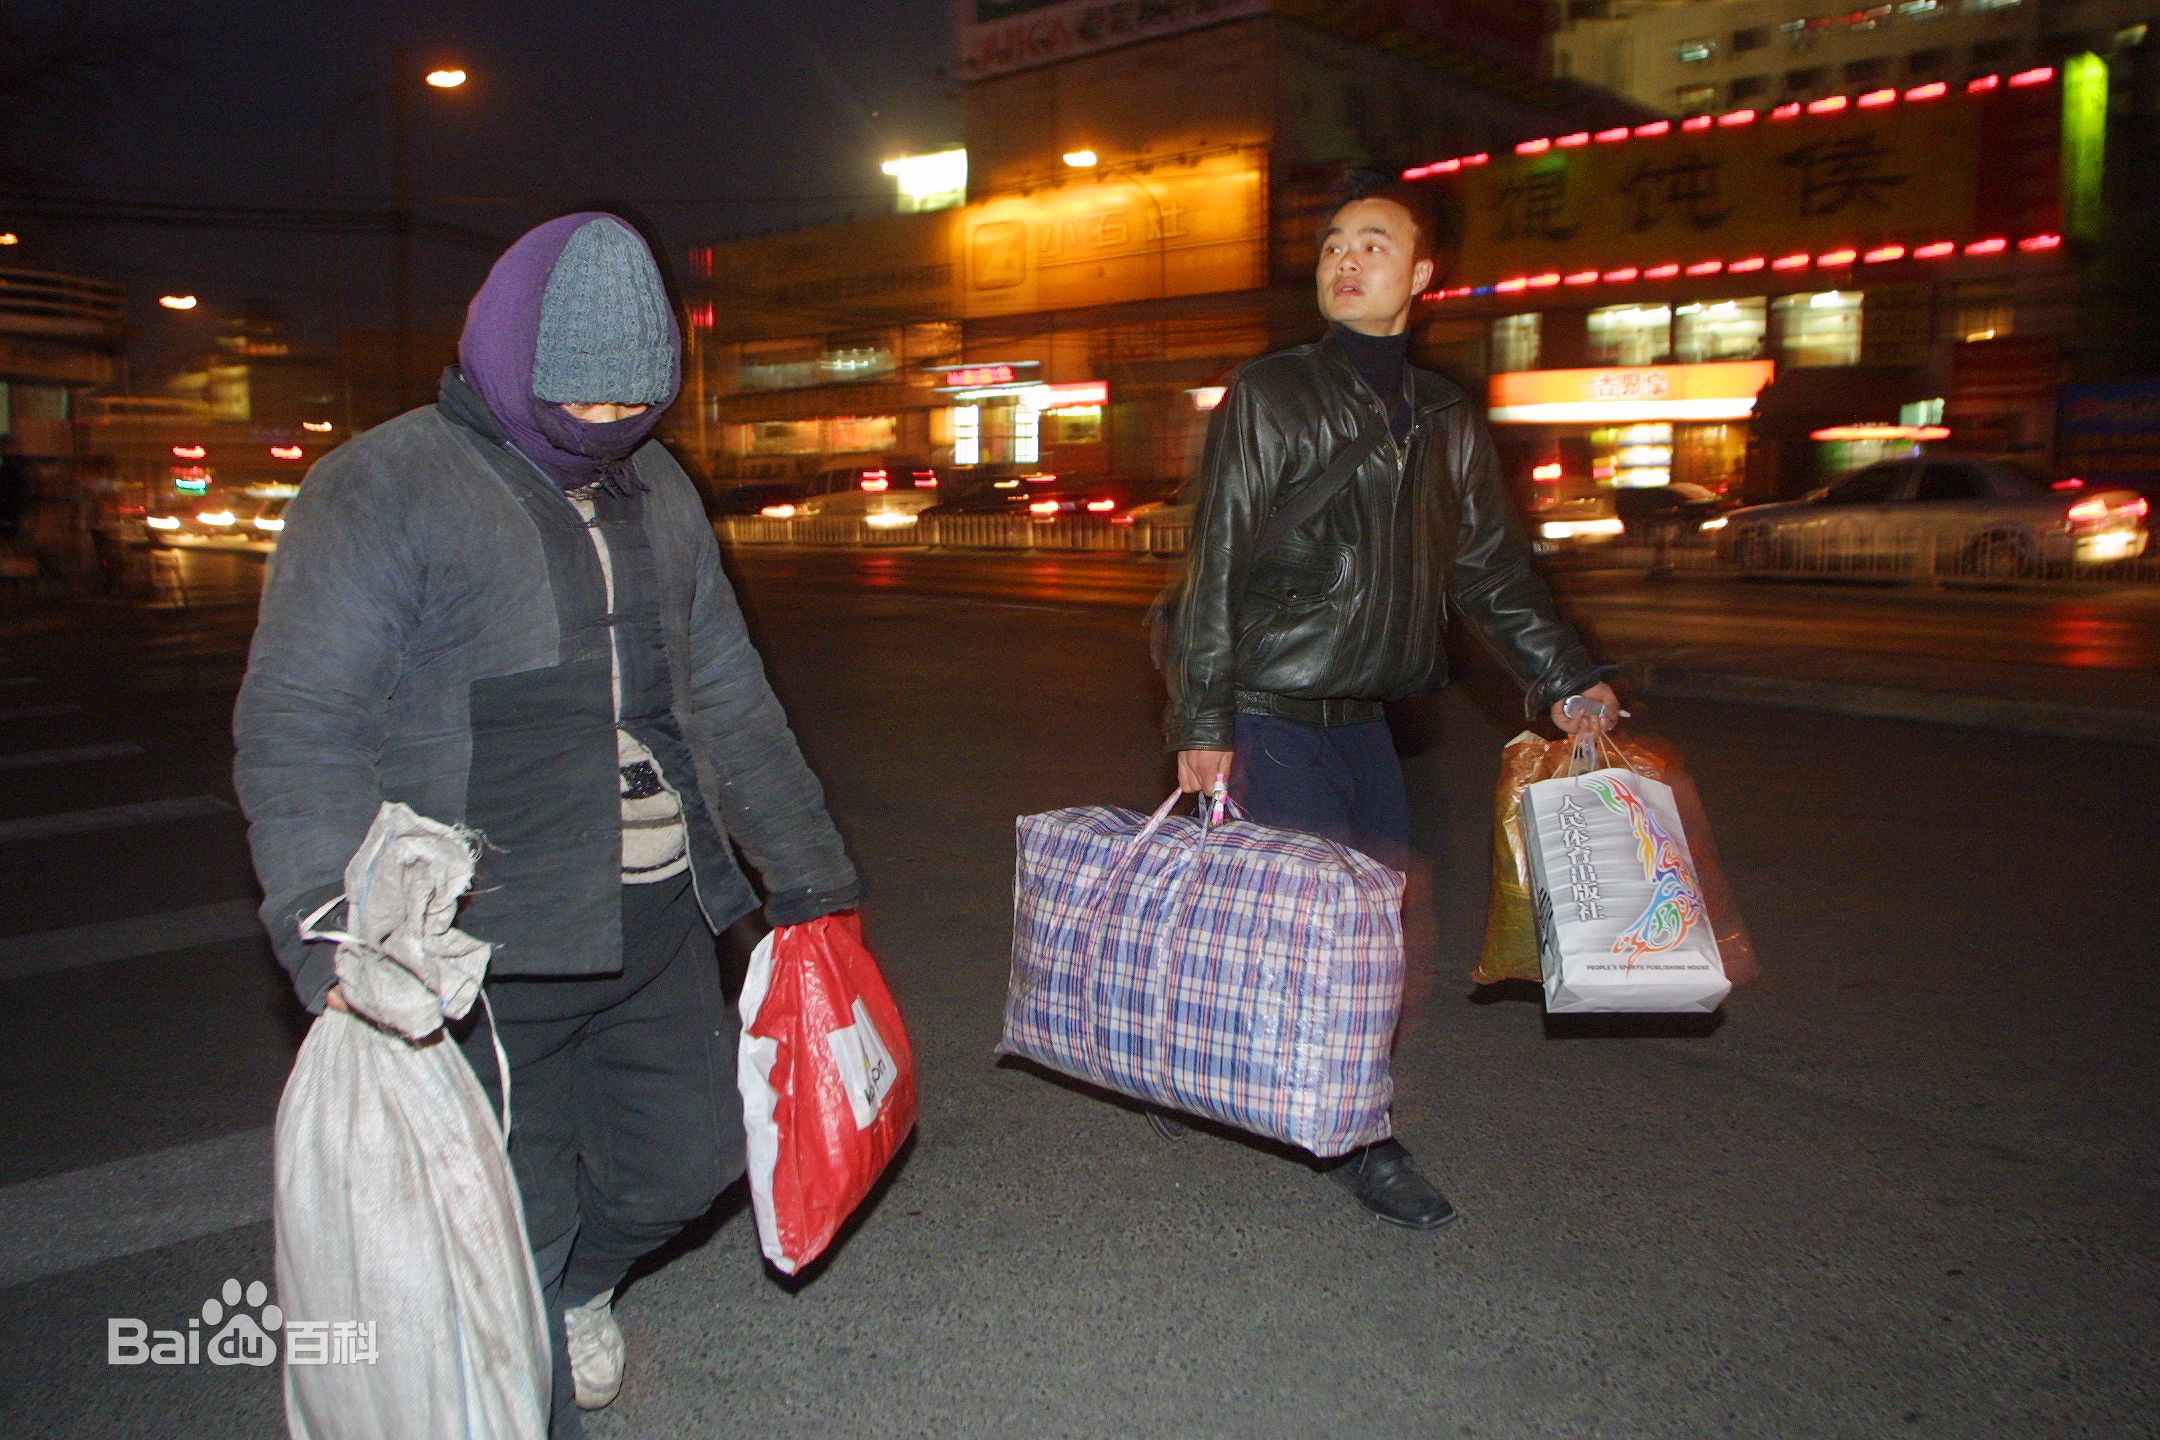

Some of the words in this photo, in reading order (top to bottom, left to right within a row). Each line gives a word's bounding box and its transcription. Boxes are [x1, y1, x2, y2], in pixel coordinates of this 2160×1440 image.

[1558, 795, 1606, 923] 人民体育出版社
[1586, 963, 1617, 971] PEOPLE'S
